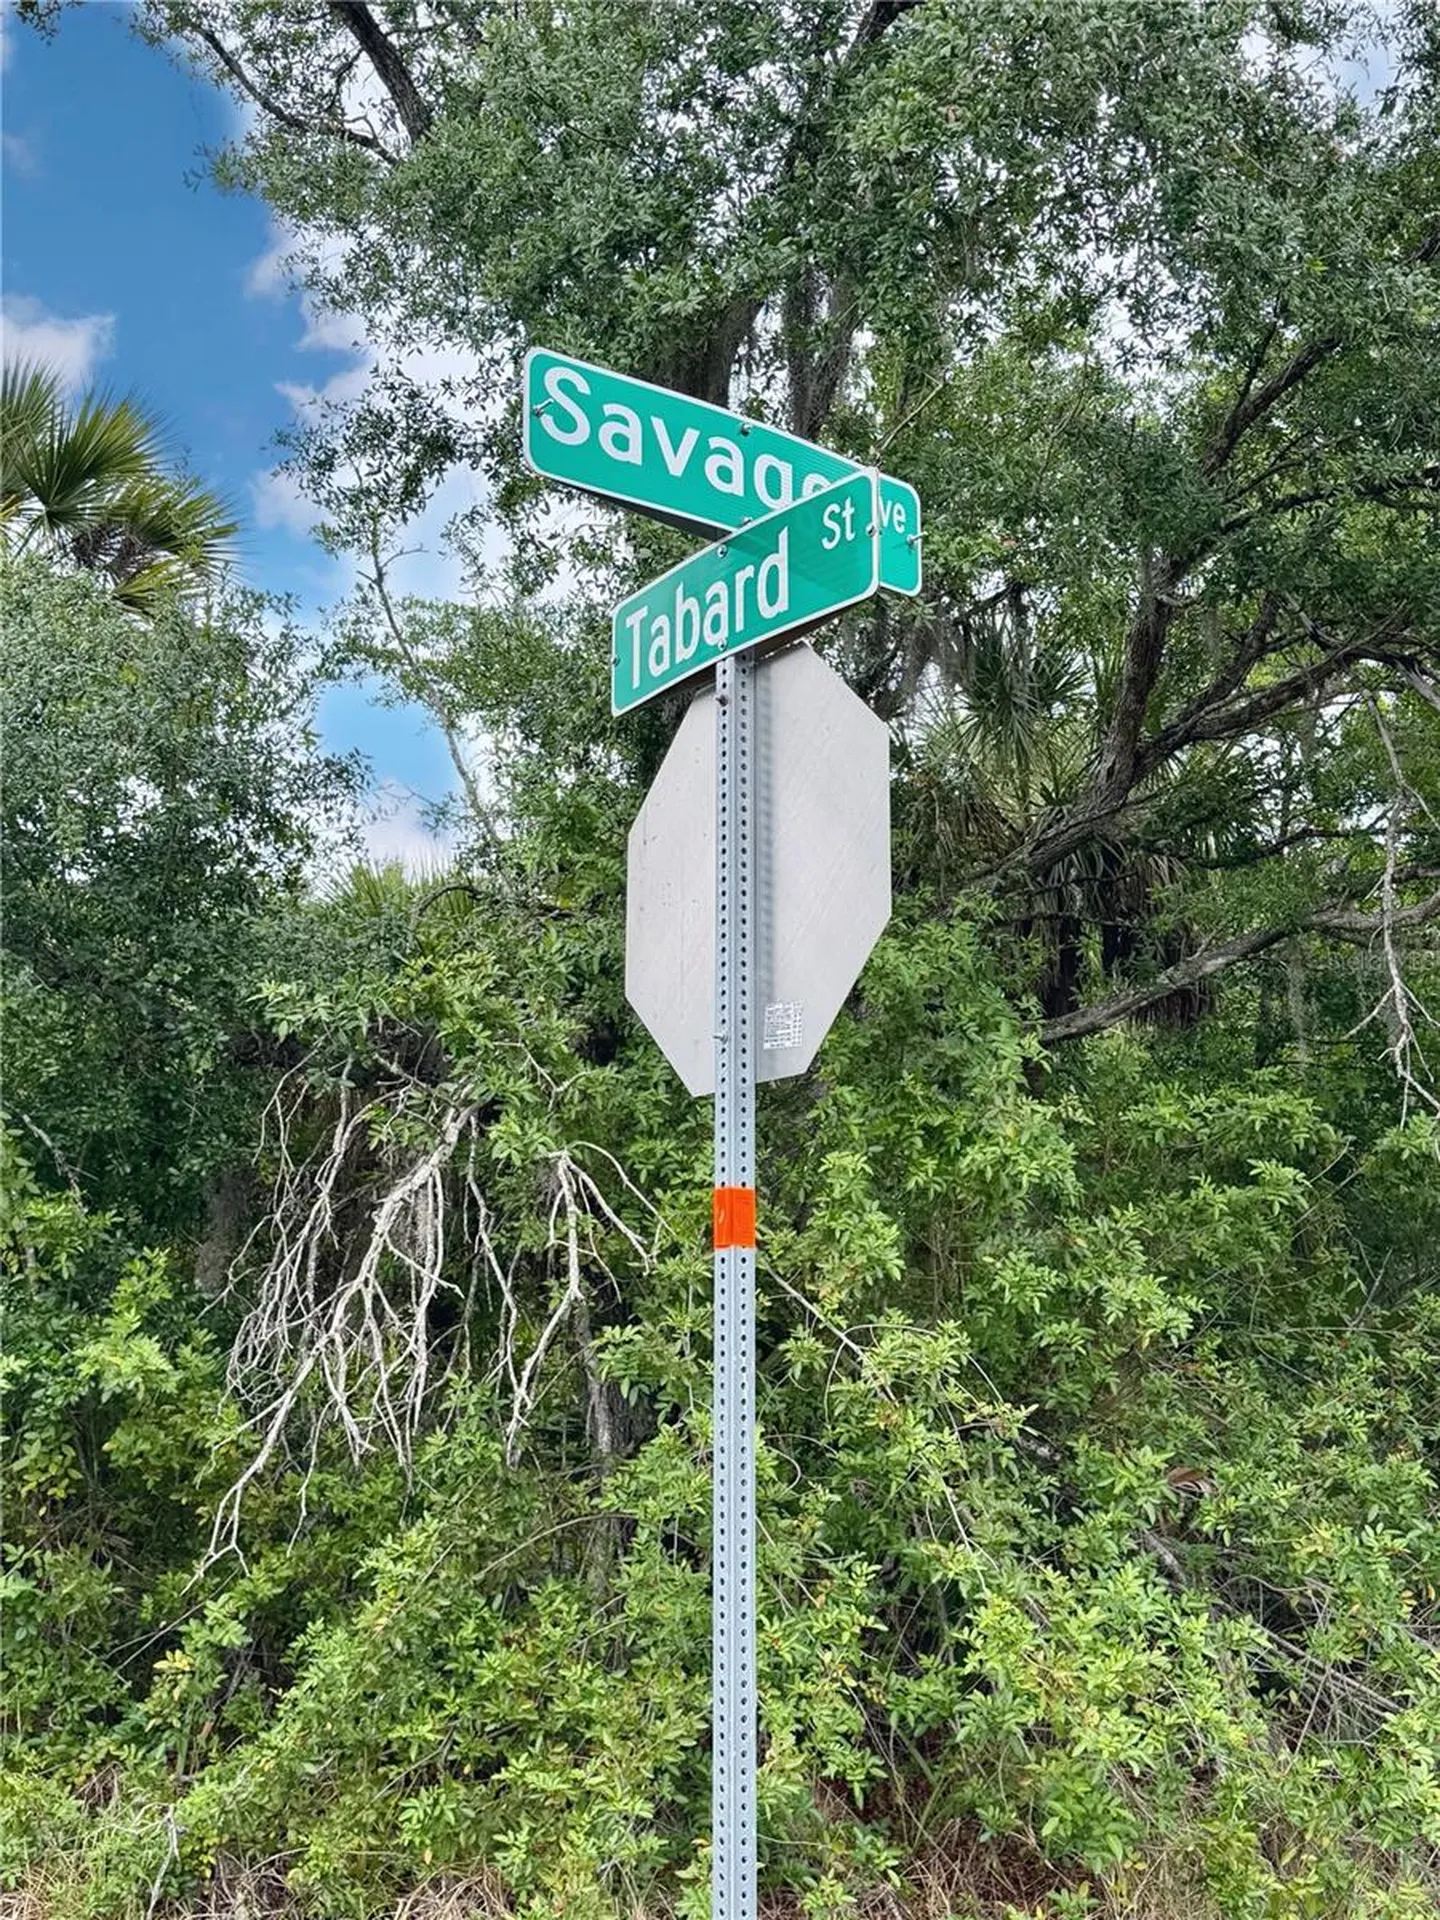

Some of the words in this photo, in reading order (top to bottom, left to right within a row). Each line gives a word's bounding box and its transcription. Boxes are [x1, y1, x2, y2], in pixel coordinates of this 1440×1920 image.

[877, 495, 906, 534] ve
[625, 526, 790, 690] Tabard
[822, 496, 856, 550] St
